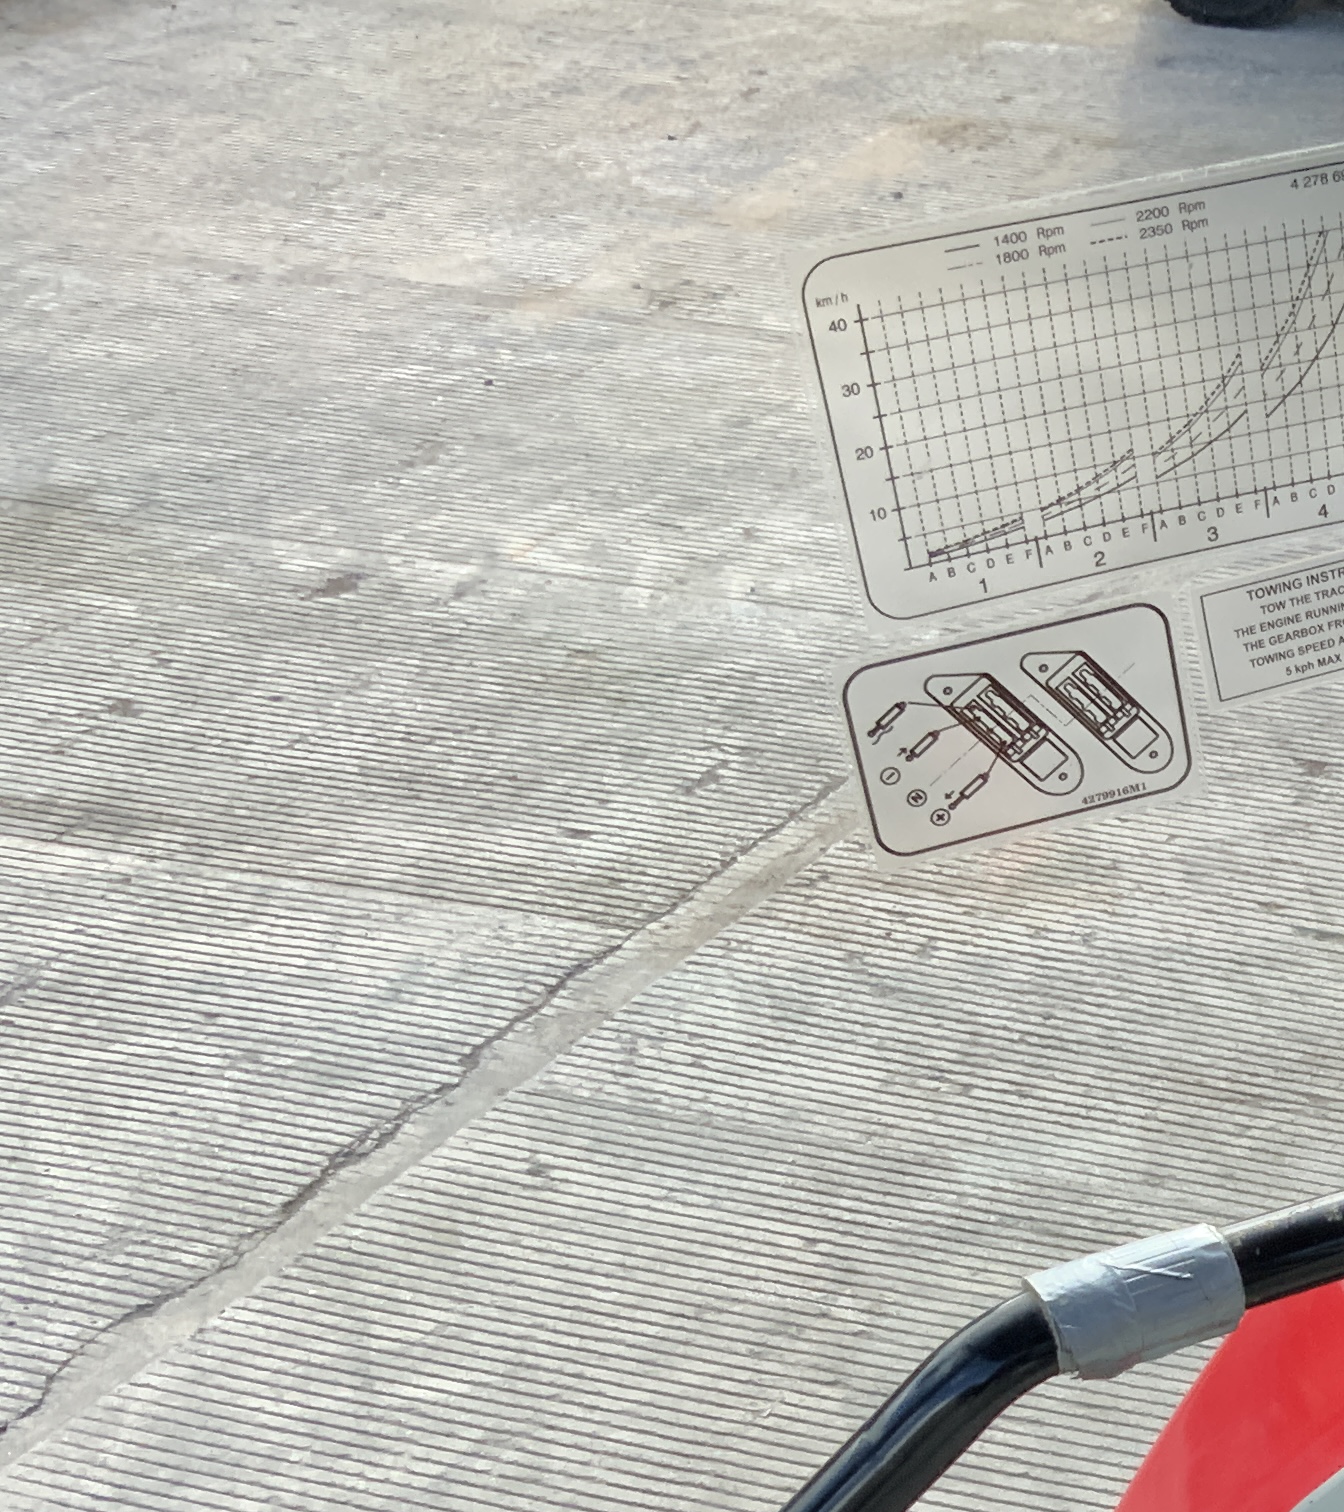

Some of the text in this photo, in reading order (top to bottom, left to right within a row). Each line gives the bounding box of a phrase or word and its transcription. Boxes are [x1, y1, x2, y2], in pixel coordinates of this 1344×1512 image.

[1290, 178, 1299, 190] 4
[1304, 172, 1328, 187] 278
[1136, 200, 1206, 222] 2200 Rpm
[994, 224, 1065, 247] 1400 Rpm
[1139, 217, 1209, 240] 2350 Rpm
[996, 242, 1066, 265] 1800 Rpm
[828, 318, 848, 332] 40
[841, 382, 861, 397] 30
[855, 445, 874, 461] 20
[870, 506, 887, 521] 10
[928, 572, 938, 582] A
[947, 567, 957, 578] B
[966, 562, 977, 574] C
[986, 557, 996, 569] D
[1005, 553, 1015, 565] E
[1025, 549, 1033, 560] F
[1044, 545, 1054, 556] A
[1063, 540, 1073, 551] B
[1083, 535, 1093, 547] C
[1102, 531, 1112, 542] D
[1121, 527, 1131, 538] E
[1141, 523, 1149, 534] F
[1159, 519, 1168, 530] A
[1178, 515, 1187, 526] B
[1197, 510, 1207, 522] C
[1216, 507, 1225, 518] D
[1235, 503, 1244, 514] E
[1254, 499, 1262, 510] F
[1272, 495, 1281, 506] A
[1290, 491, 1298, 502] B
[1308, 487, 1318, 499] C
[1327, 484, 1336, 495] D
[979, 503, 1329, 594] 1 2 3 4
[1246, 578, 1303, 602] TOWING
[1260, 600, 1287, 615] TOW
[1289, 593, 1312, 608] THE
[1233, 626, 1257, 639] THE
[1260, 611, 1302, 632] ENGINE
[1243, 639, 1266, 653] THE
[1268, 624, 1325, 646] GEARBOX
[1249, 649, 1295, 669] TOWING
[1298, 637, 1336, 656] SPEED
[1285, 665, 1292, 676] 5
[1294, 660, 1315, 676] kph
[1317, 654, 1342, 668] MAX
